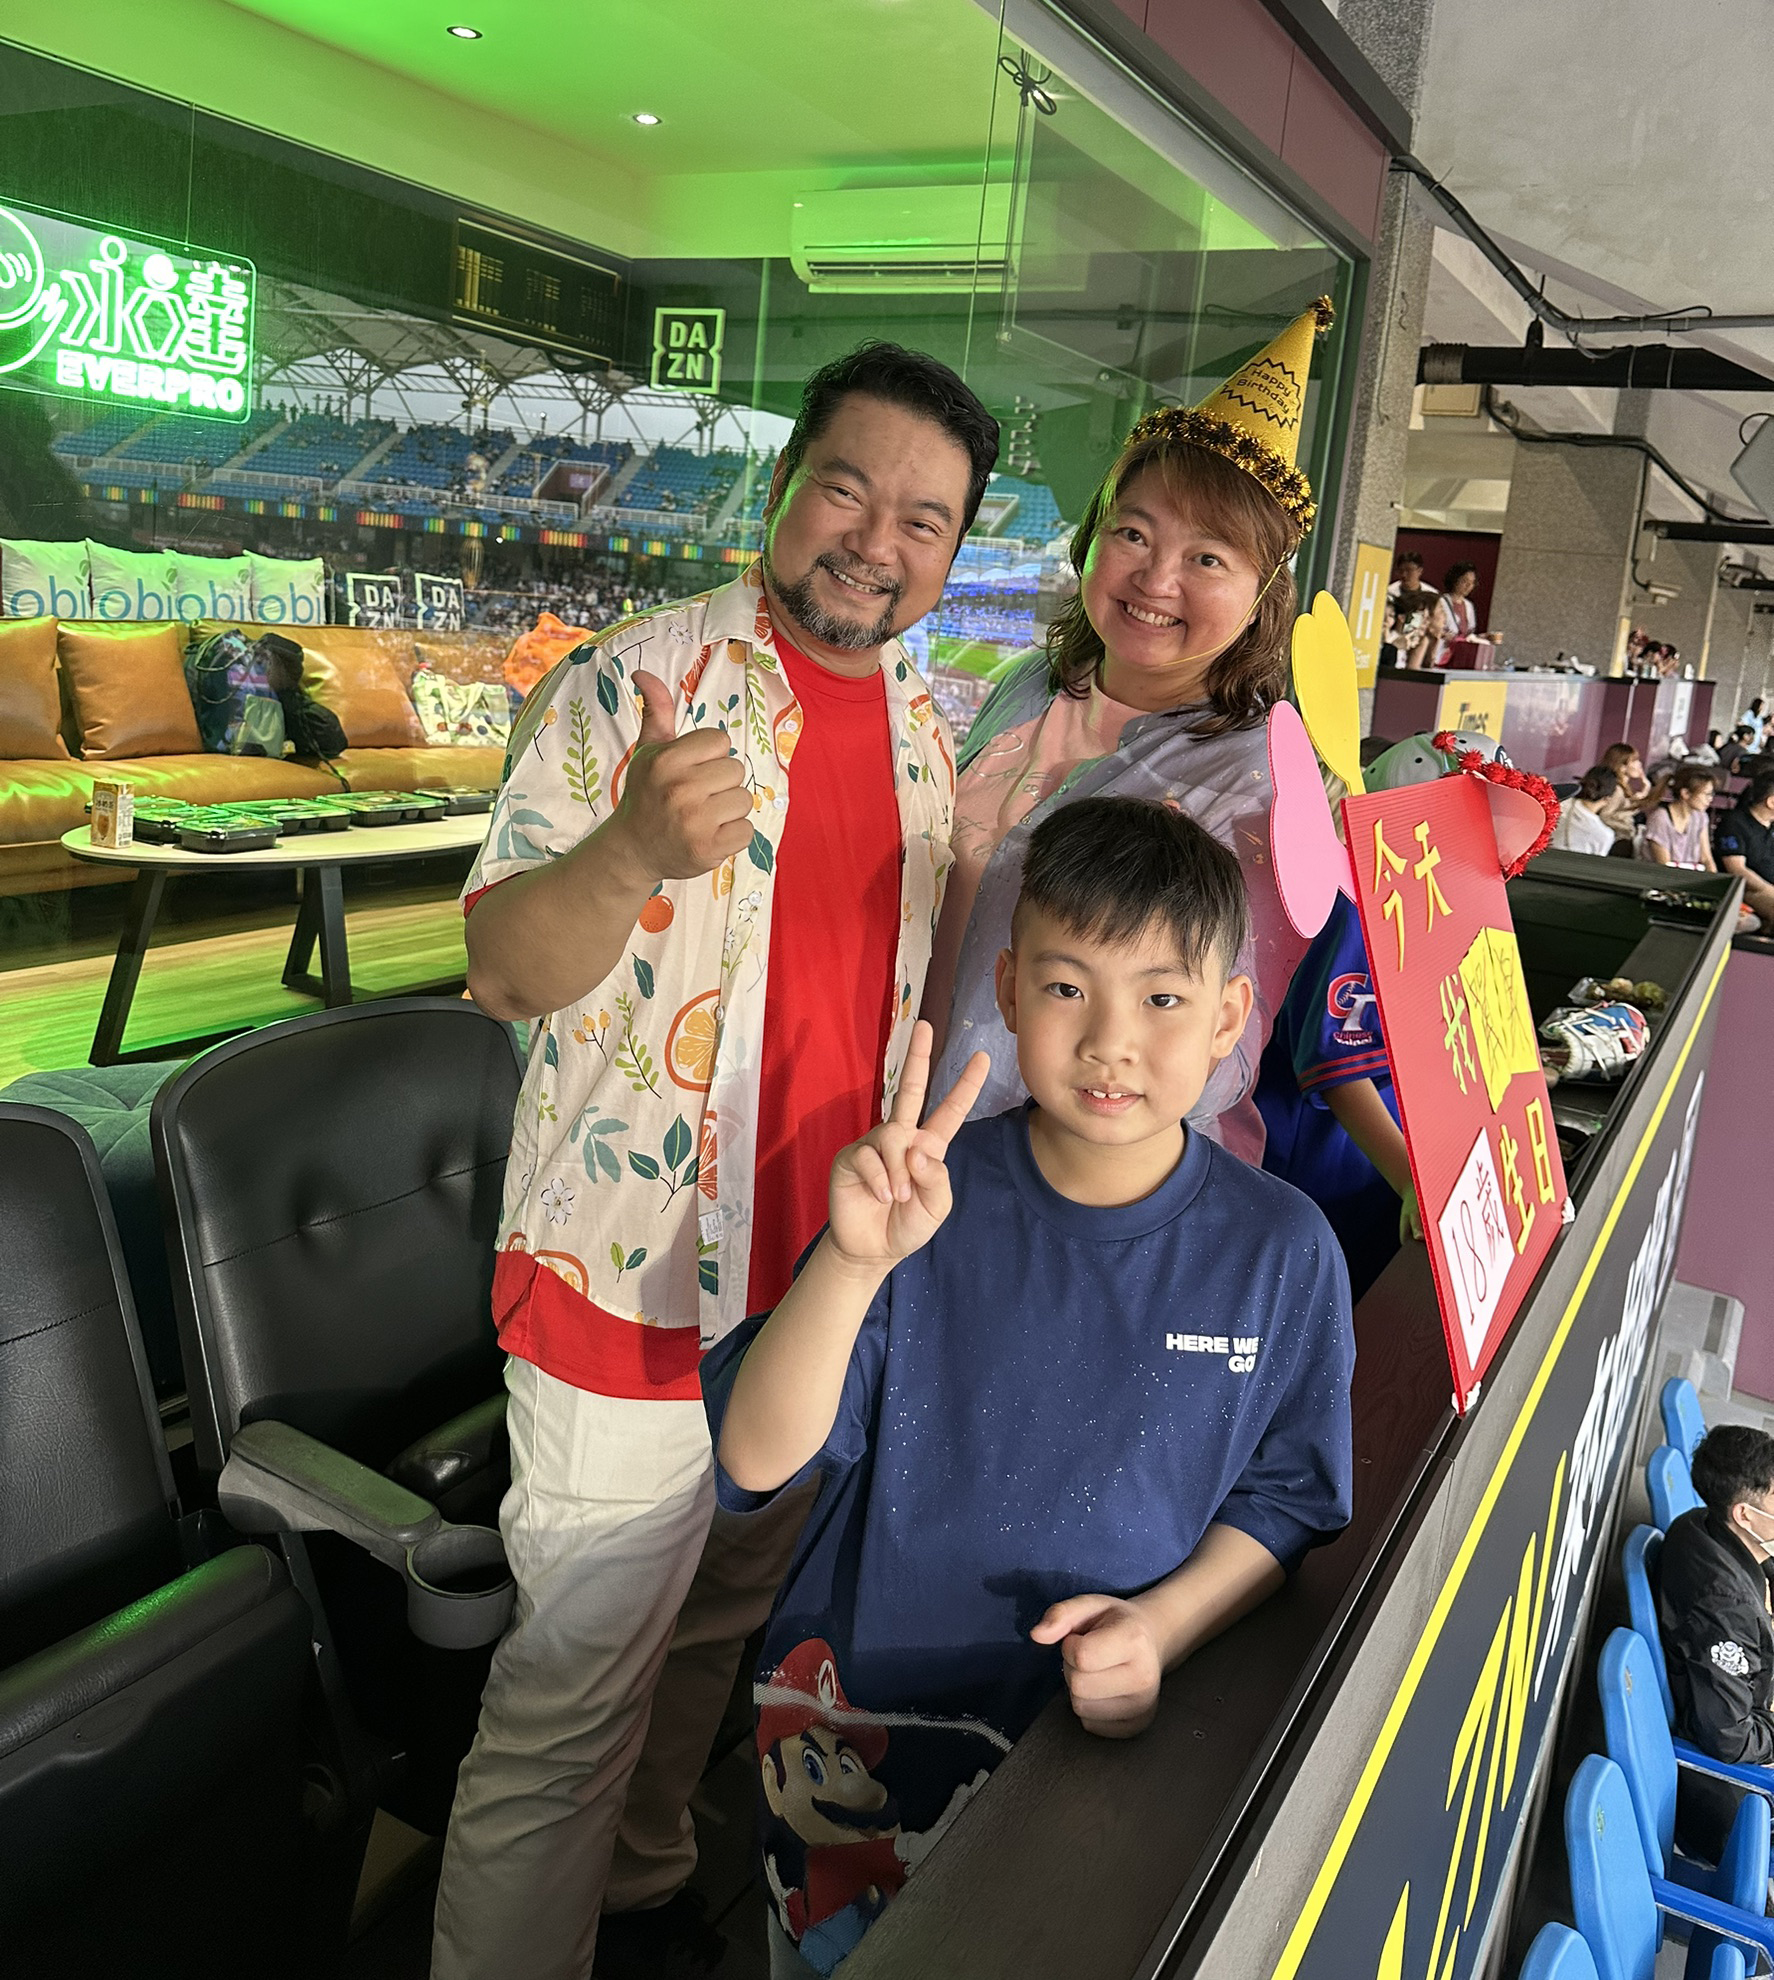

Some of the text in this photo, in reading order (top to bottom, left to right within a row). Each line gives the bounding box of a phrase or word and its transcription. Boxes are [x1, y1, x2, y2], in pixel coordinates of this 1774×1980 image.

[669, 320, 709, 349] DA
[56, 349, 245, 413] EVERPRO
[666, 352, 706, 380] ZN
[1251, 370, 1291, 397] Happy
[1236, 378, 1290, 414] Birthday
[10, 575, 86, 619] obi
[99, 577, 172, 621] obi
[176, 579, 245, 623] obi
[257, 581, 321, 624] obi
[364, 584, 395, 608] DA
[431, 585, 460, 610] DA
[1371, 817, 1454, 973] 今天
[1439, 973, 1478, 1096] 我
[1451, 1159, 1506, 1326] 18歲
[1498, 1096, 1556, 1256] 生日
[1166, 1333, 1260, 1354] HERE WE
[1228, 1355, 1257, 1373] GO
